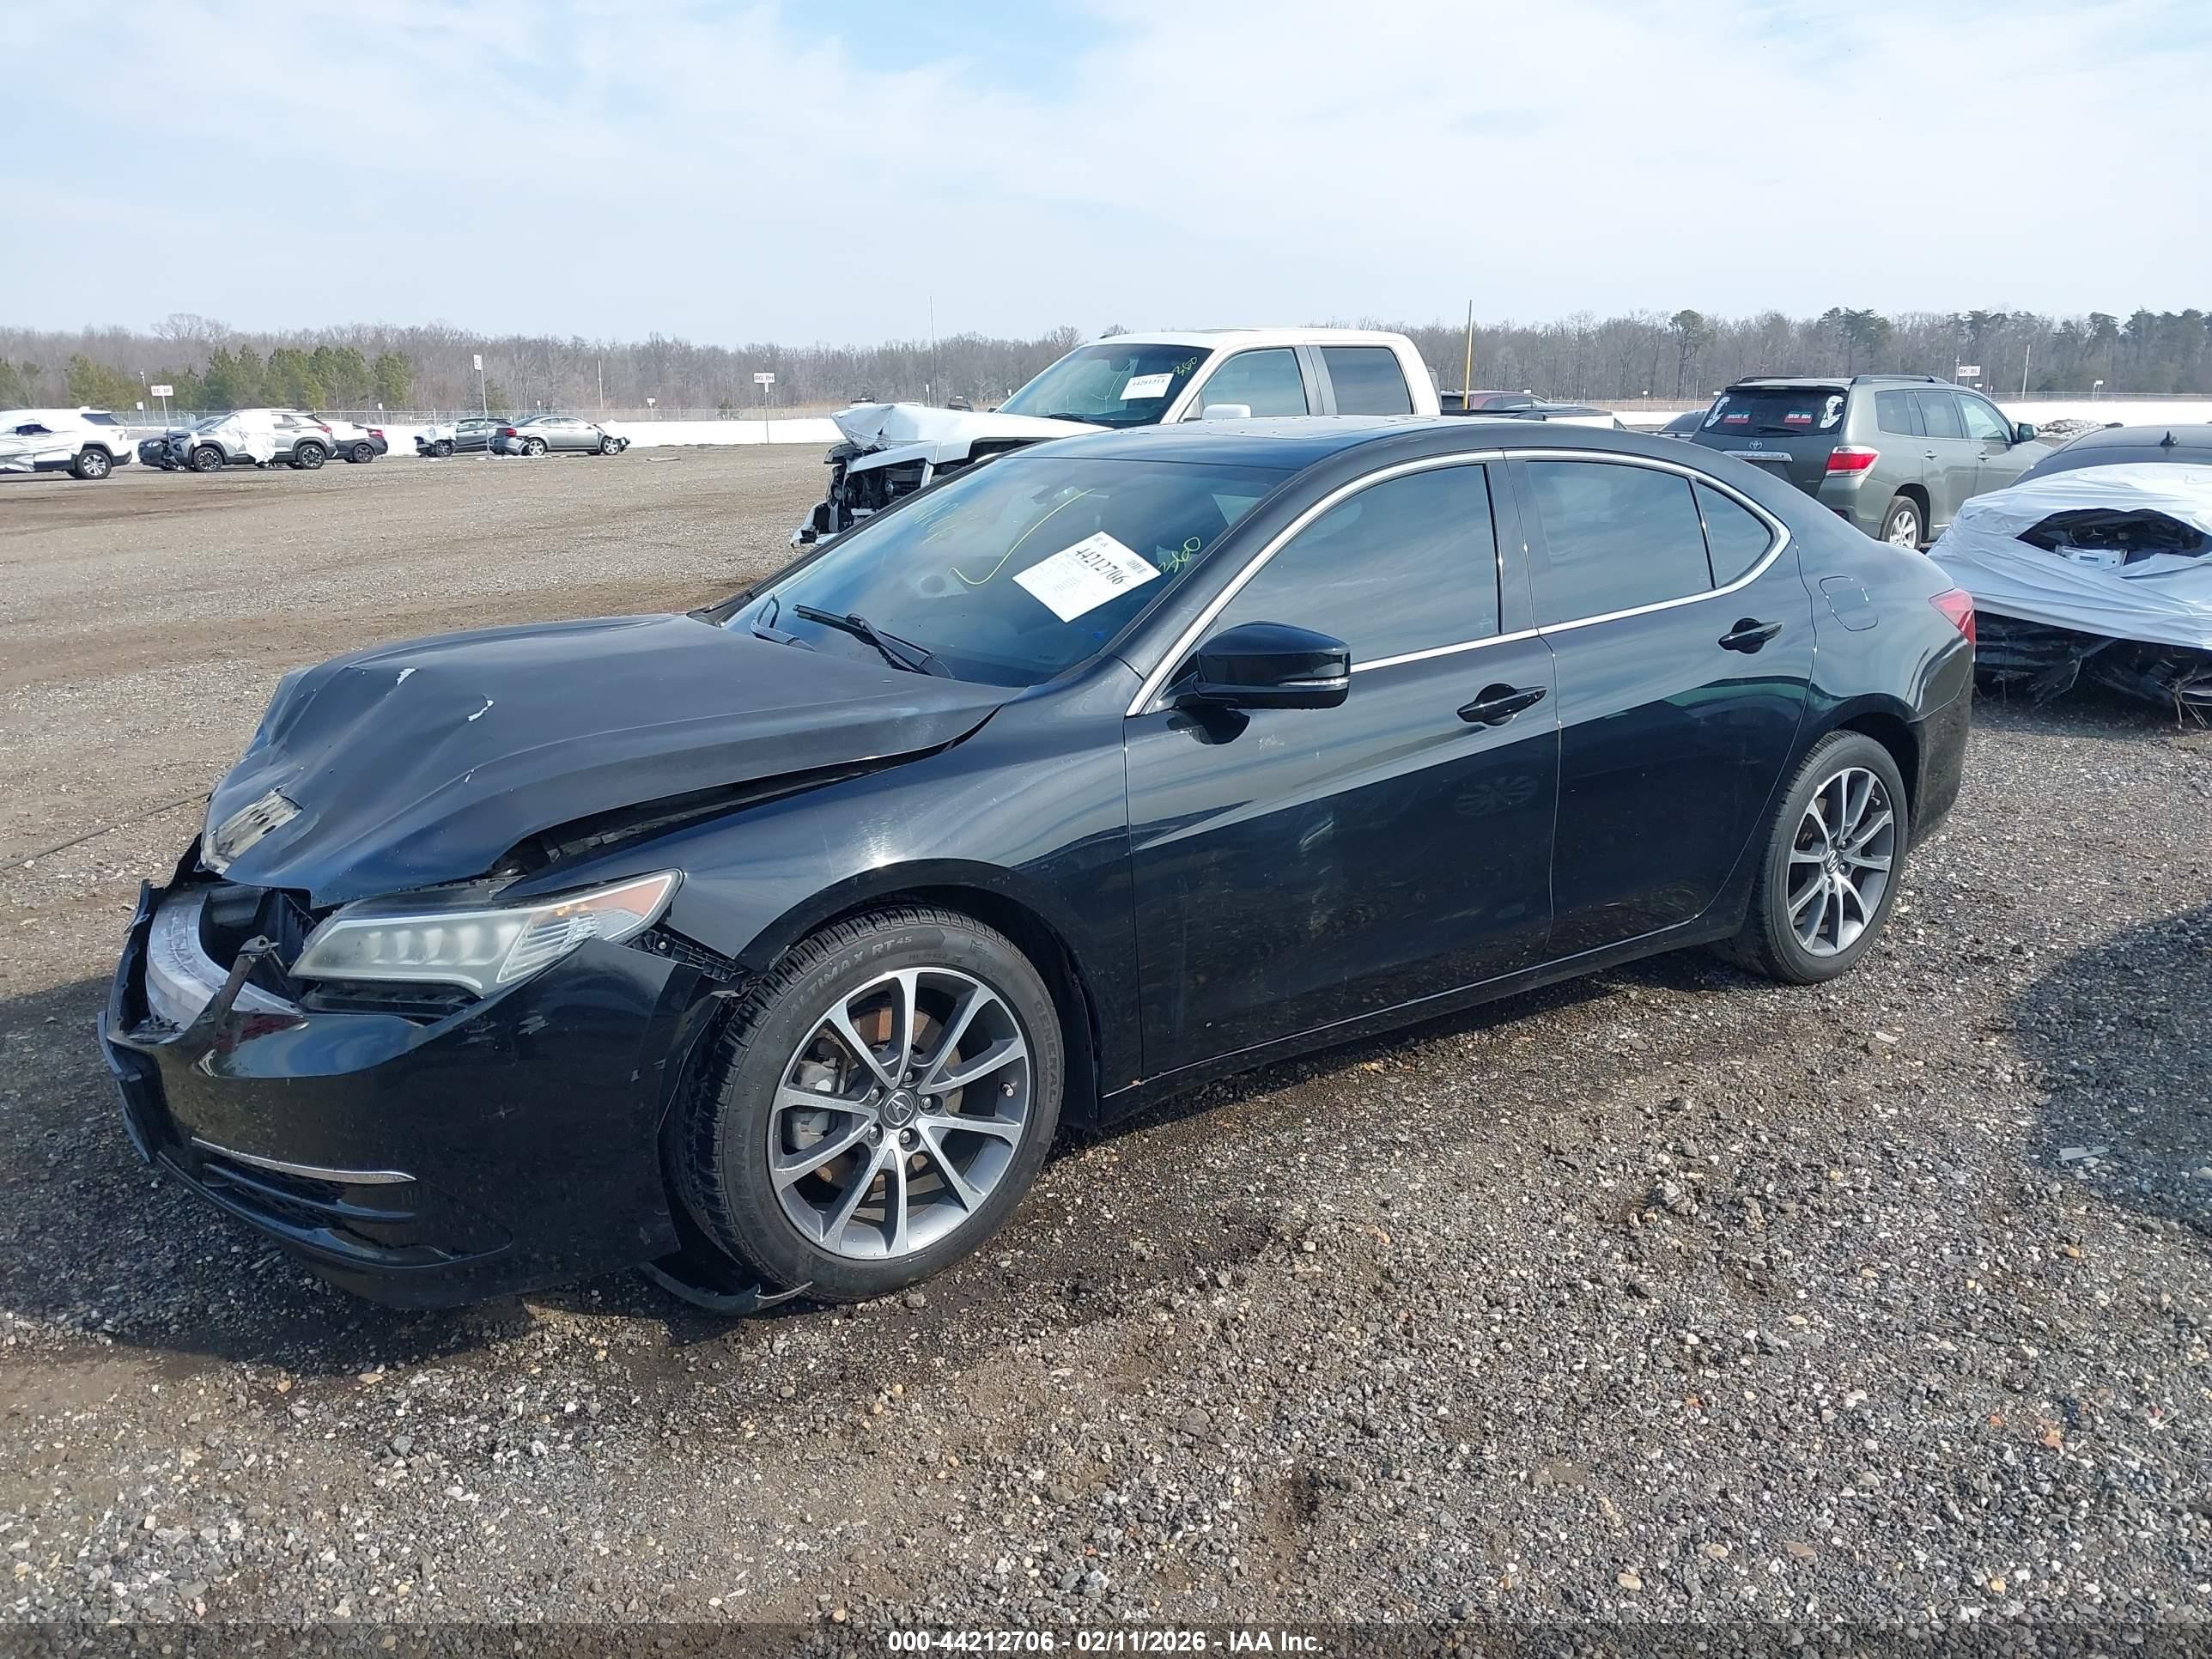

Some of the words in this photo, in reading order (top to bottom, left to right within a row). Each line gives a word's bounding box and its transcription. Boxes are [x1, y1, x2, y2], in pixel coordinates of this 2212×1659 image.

[1074, 547, 1131, 586] 44212706
[789, 951, 865, 1017] ALTIMAX
[1034, 1000, 1059, 1104] GENERAL
